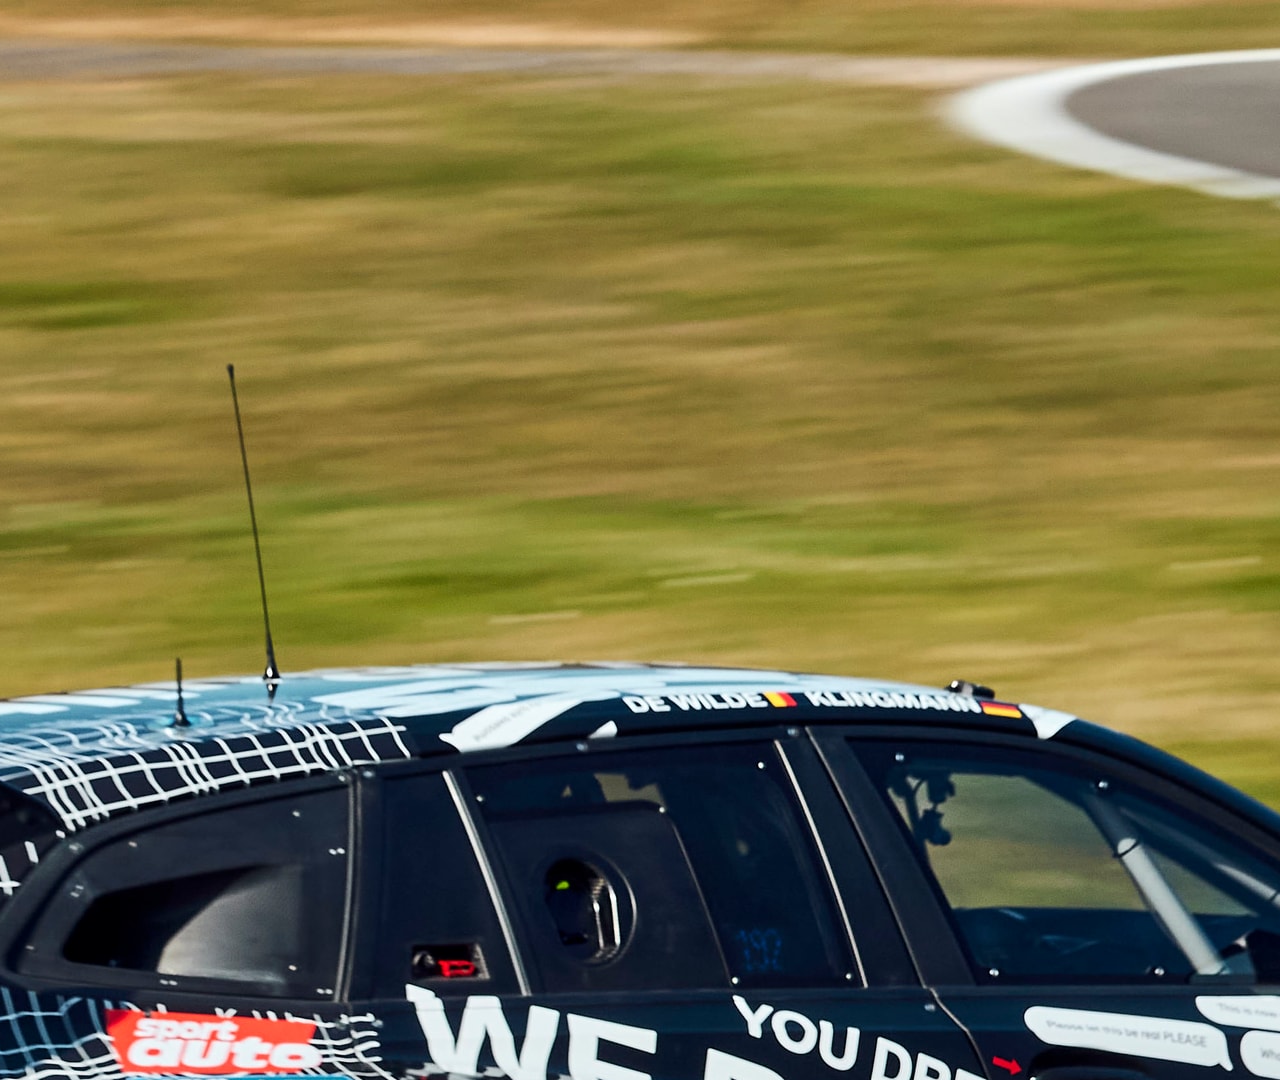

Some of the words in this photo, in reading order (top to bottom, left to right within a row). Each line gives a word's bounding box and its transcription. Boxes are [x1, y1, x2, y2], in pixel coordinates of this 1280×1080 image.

[622, 695, 671, 714] DE
[670, 692, 768, 711] WILDE
[803, 690, 982, 713] KLINGMANN
[133, 1018, 240, 1042] sport
[732, 995, 861, 1072] YOU
[1162, 1032, 1208, 1048] PLEASE
[126, 1036, 323, 1069] auto
